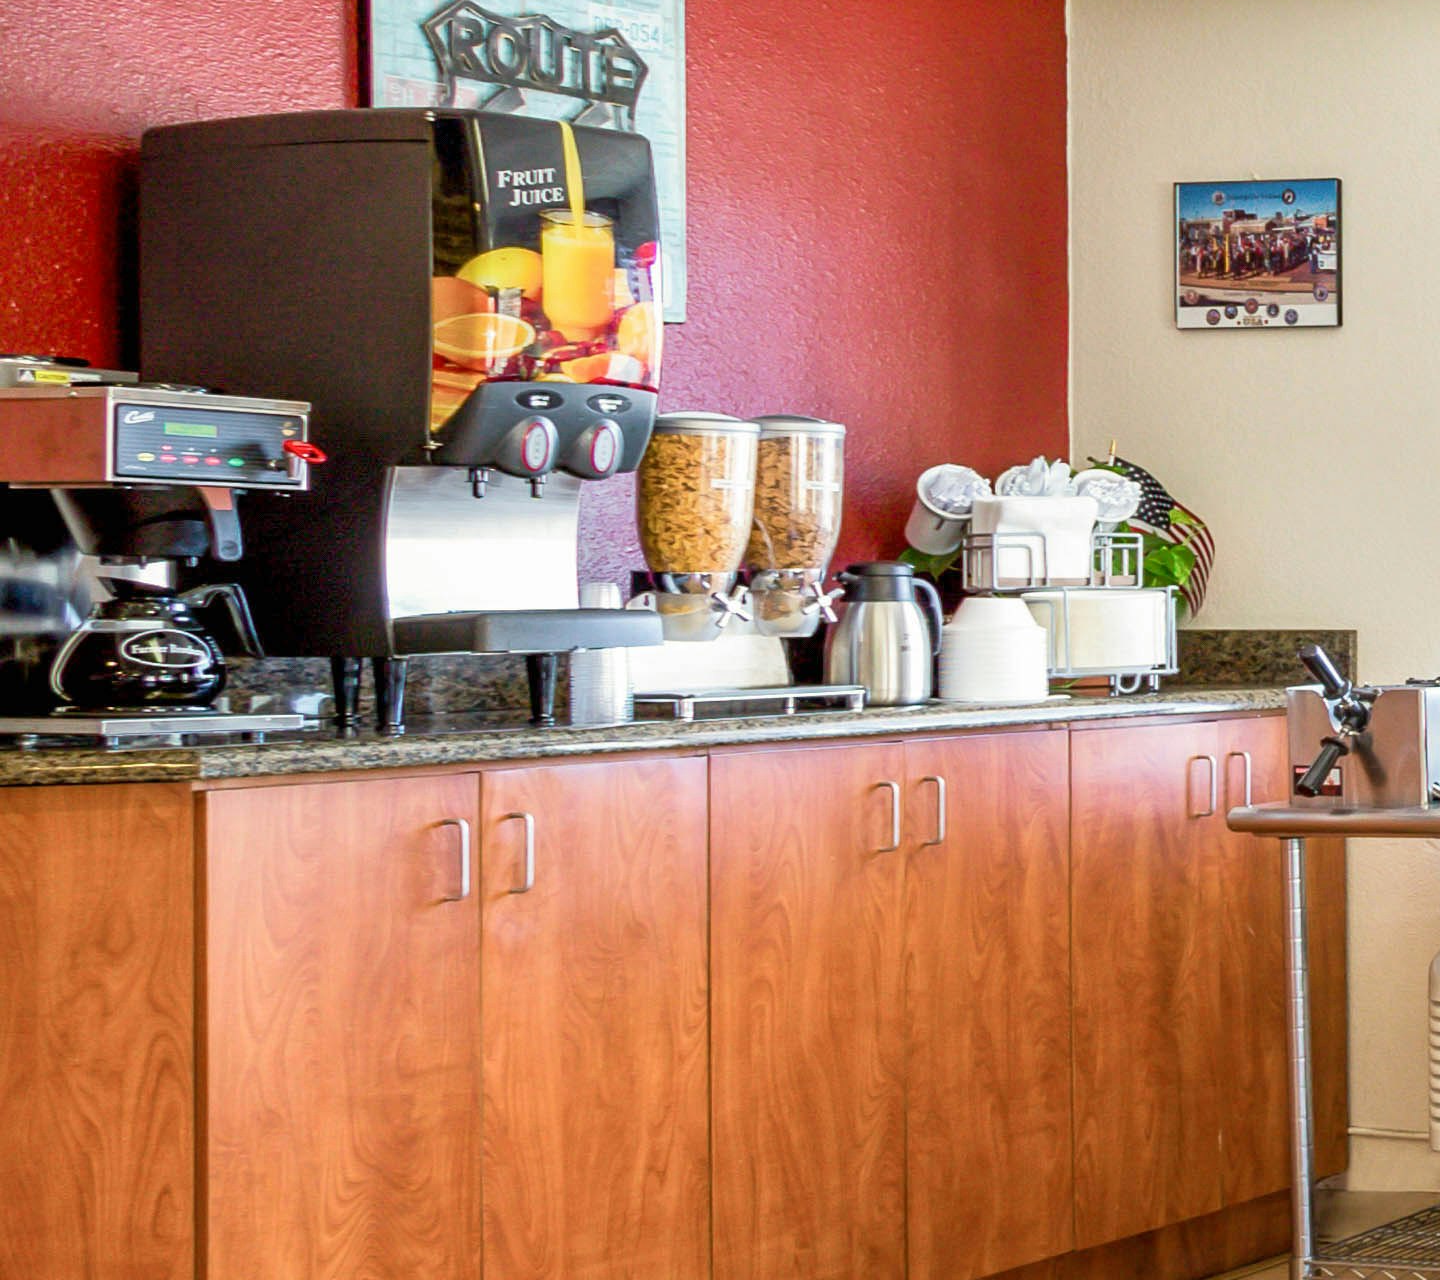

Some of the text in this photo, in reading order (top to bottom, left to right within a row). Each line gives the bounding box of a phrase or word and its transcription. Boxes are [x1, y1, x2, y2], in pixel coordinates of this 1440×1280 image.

[449, 18, 638, 105] ROUTE
[497, 167, 557, 189] FRUIT
[508, 187, 566, 207] JUICE
